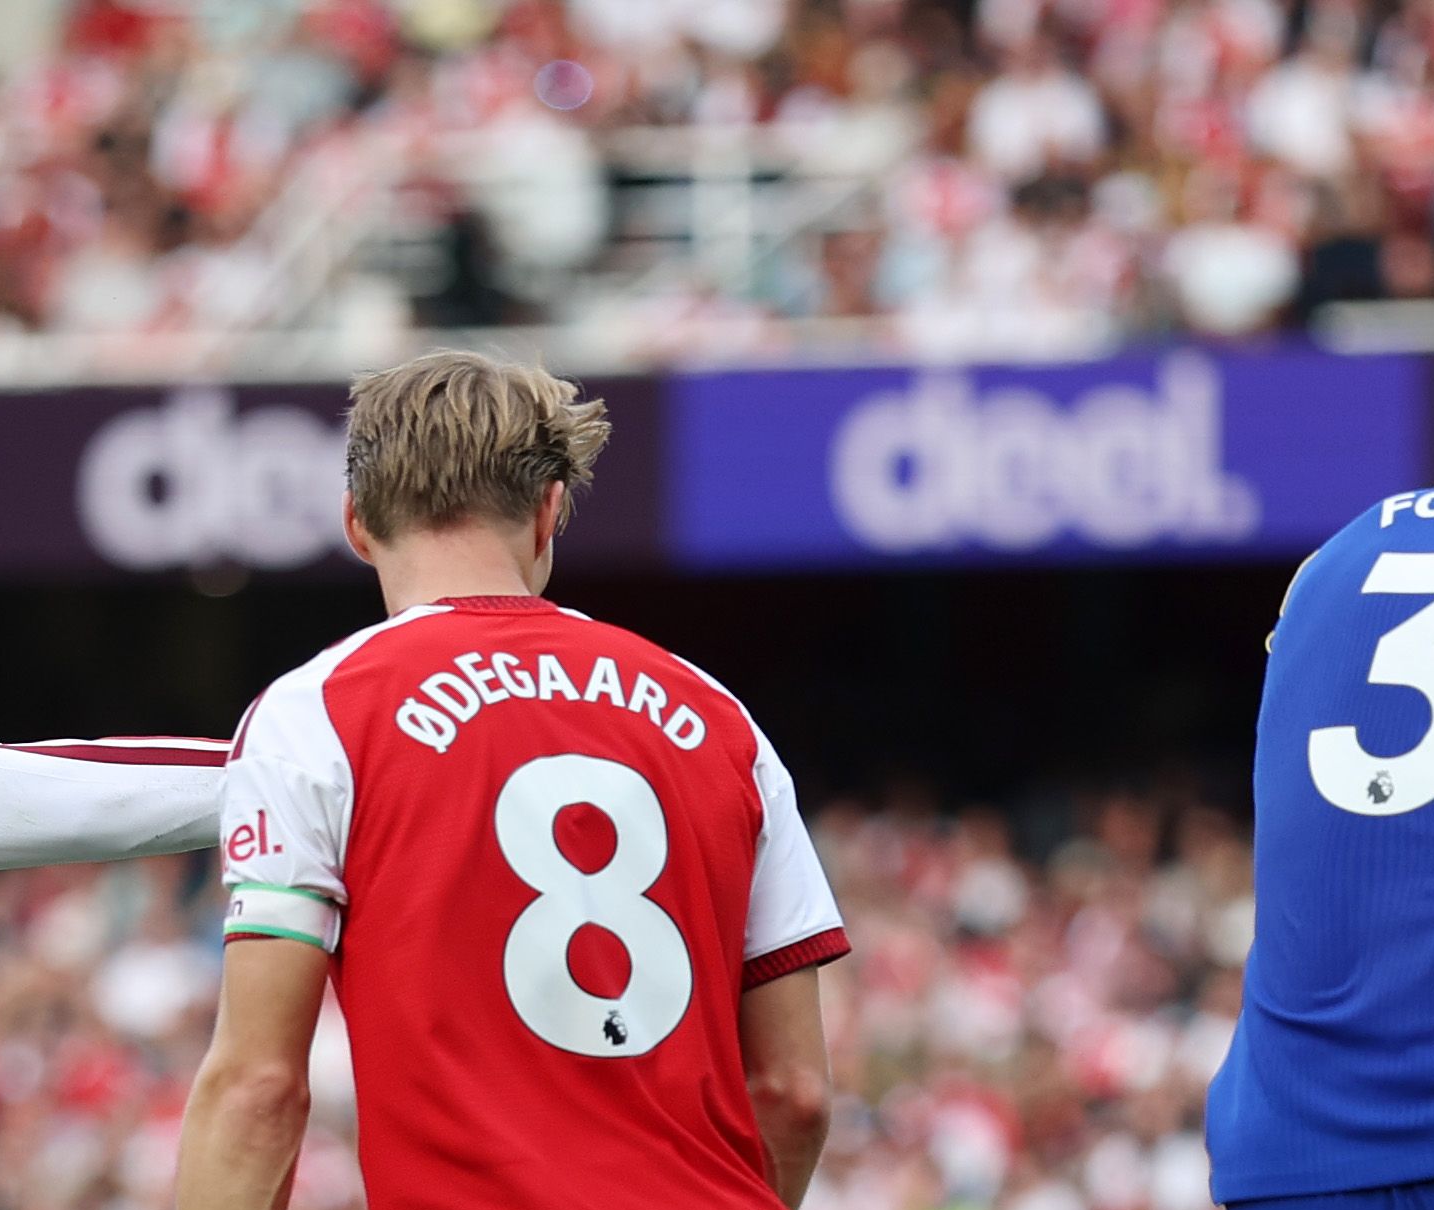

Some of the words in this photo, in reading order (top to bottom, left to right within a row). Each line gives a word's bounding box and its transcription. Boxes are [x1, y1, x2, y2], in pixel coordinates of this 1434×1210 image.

[828, 350, 1263, 552] deel.
[394, 651, 707, 754] ØDEGAARD
[221, 808, 283, 872] el.
[494, 754, 694, 1058] 8
